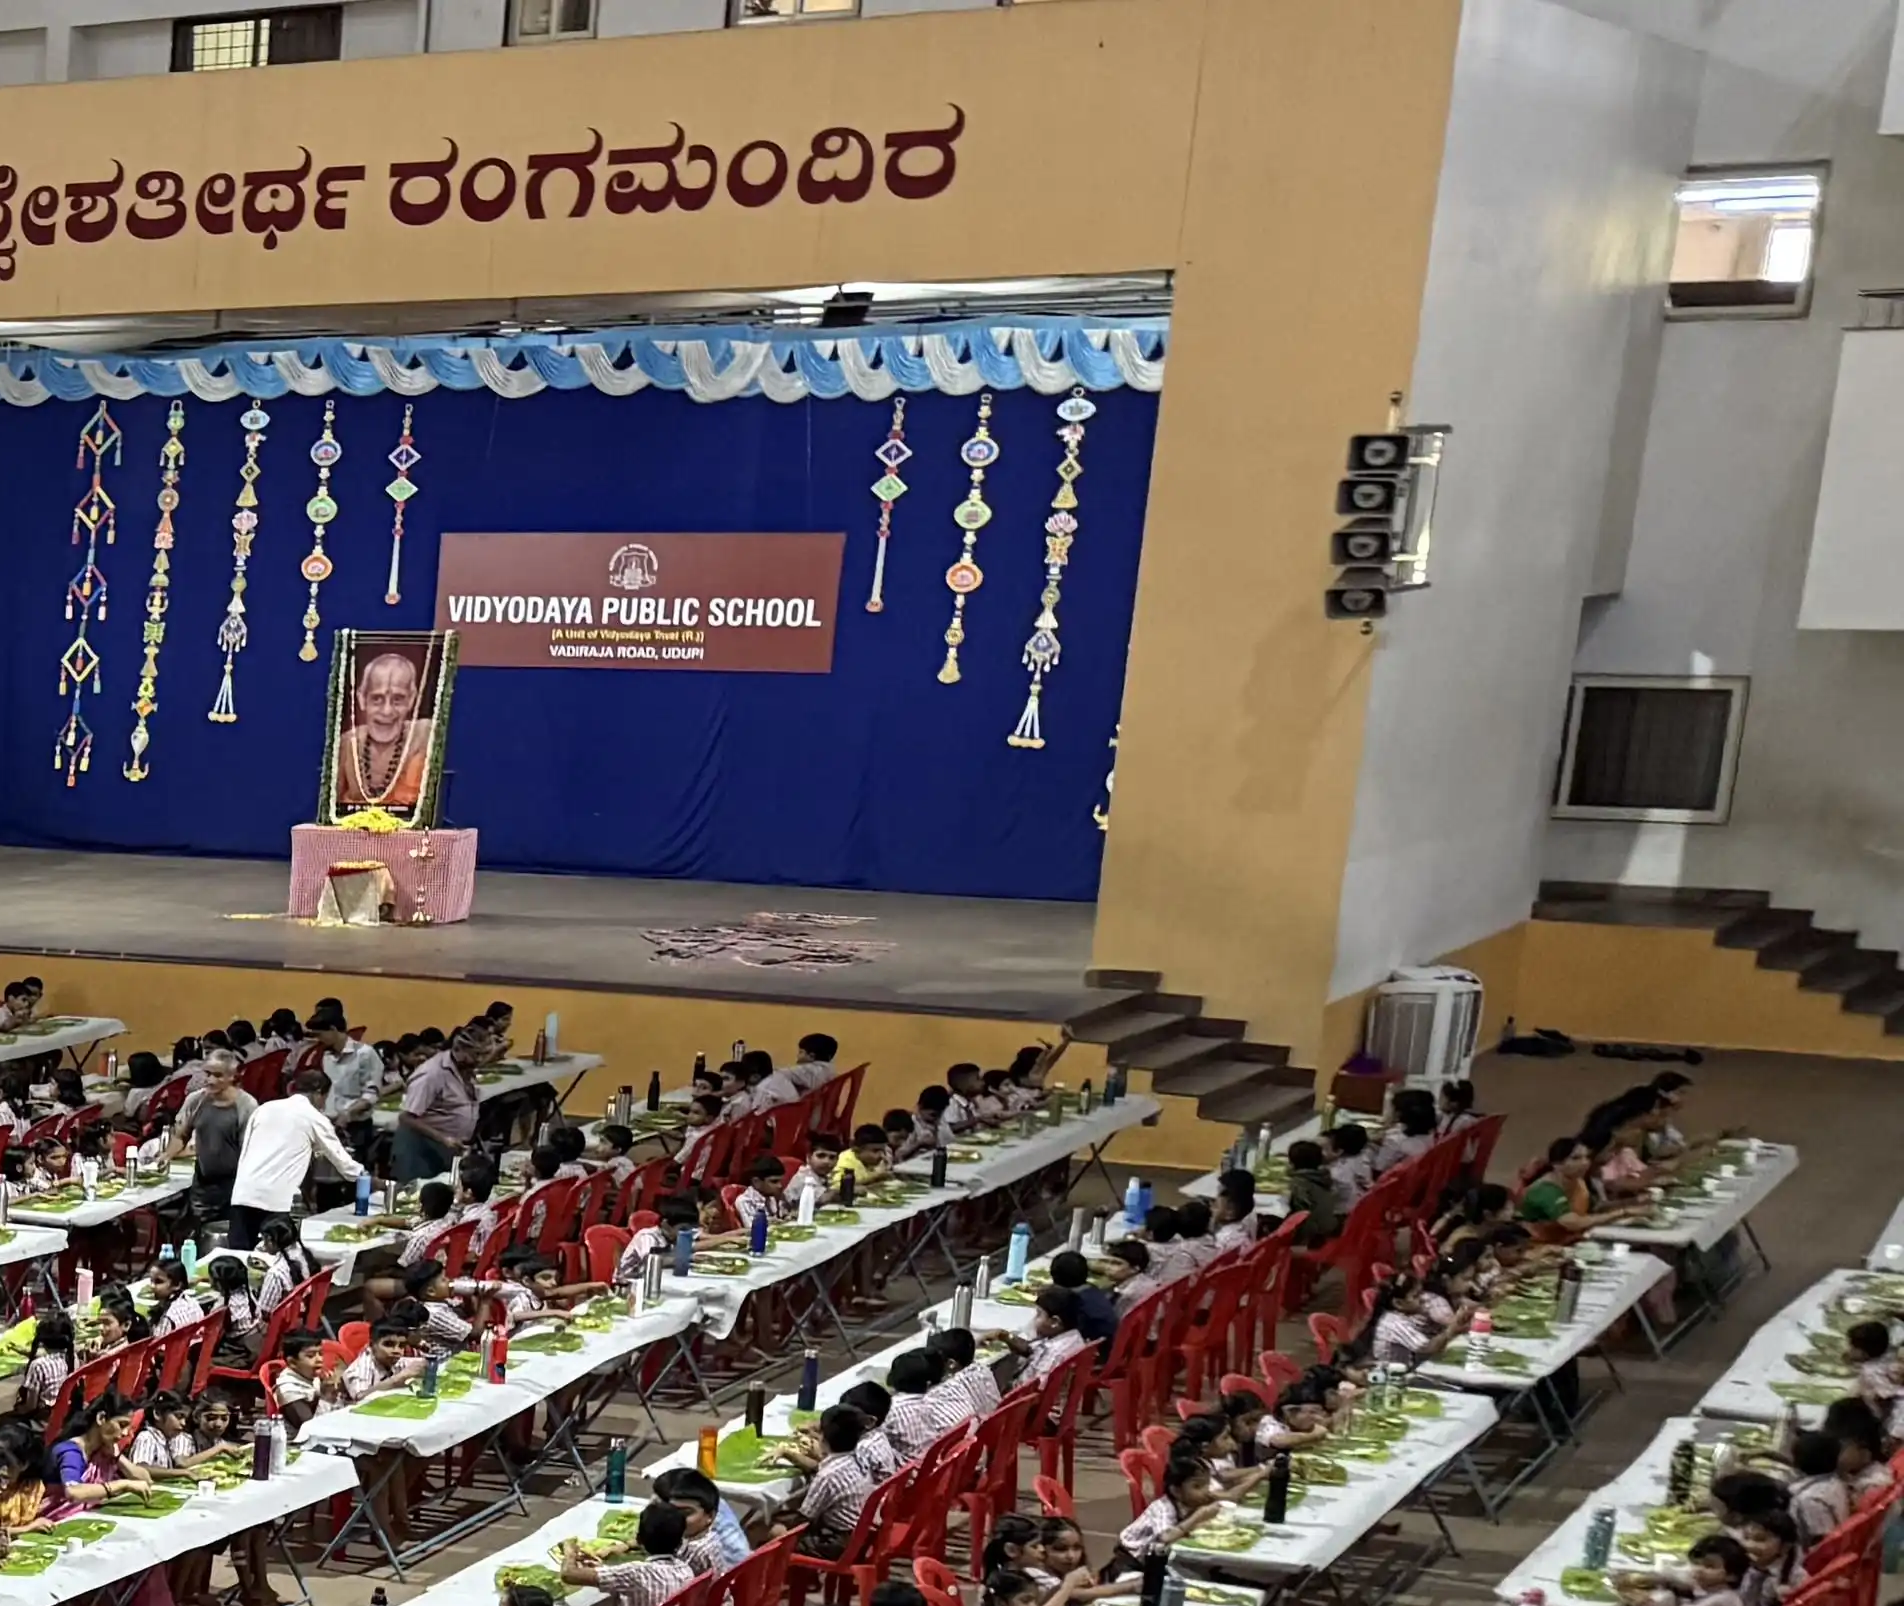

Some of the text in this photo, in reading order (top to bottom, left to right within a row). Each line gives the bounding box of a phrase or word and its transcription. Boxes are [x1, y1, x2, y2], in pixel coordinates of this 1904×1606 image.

[389, 101, 966, 227] ರಂಗಮಂದಿರ
[448, 595, 822, 628] VIDYODAYA PUBLIC SCHOOL
[565, 629, 586, 640] Unit
[587, 629, 598, 640] of
[599, 629, 652, 642] Vidyodaya
[654, 630, 679, 641] Trust
[549, 644, 705, 660] VADIRAJA ROAD, UDUPI
